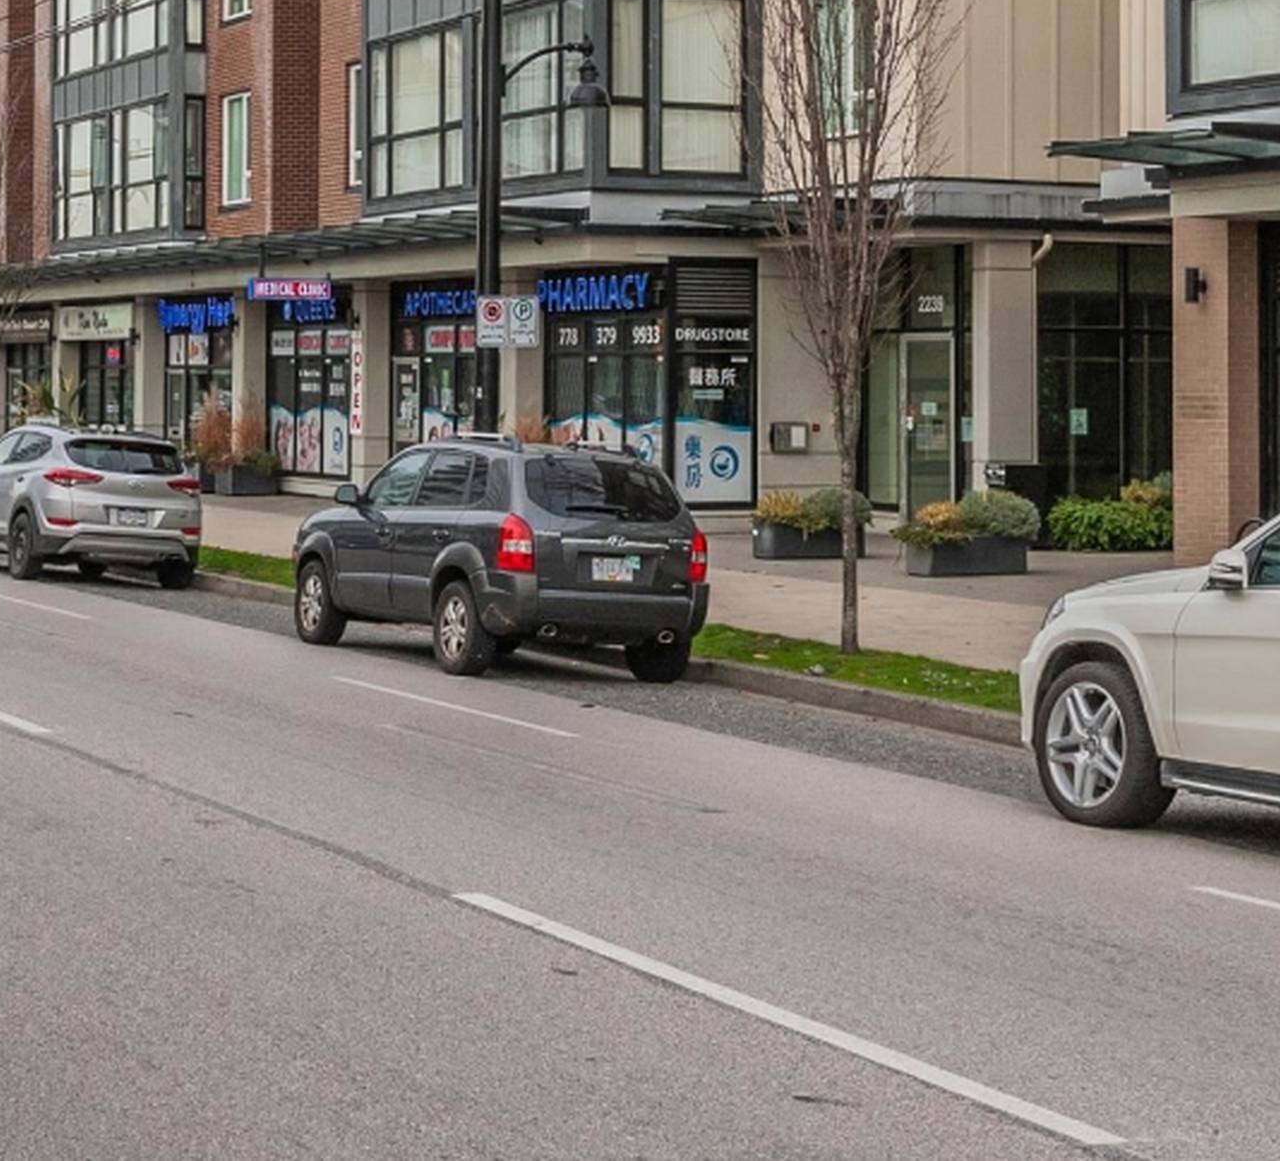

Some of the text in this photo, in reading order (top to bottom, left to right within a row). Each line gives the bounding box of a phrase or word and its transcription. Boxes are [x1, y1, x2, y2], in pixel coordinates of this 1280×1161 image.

[405, 290, 477, 316] APOTHECAR
[536, 272, 650, 313] PHARMACY
[675, 327, 751, 342] DRUGSTORE
